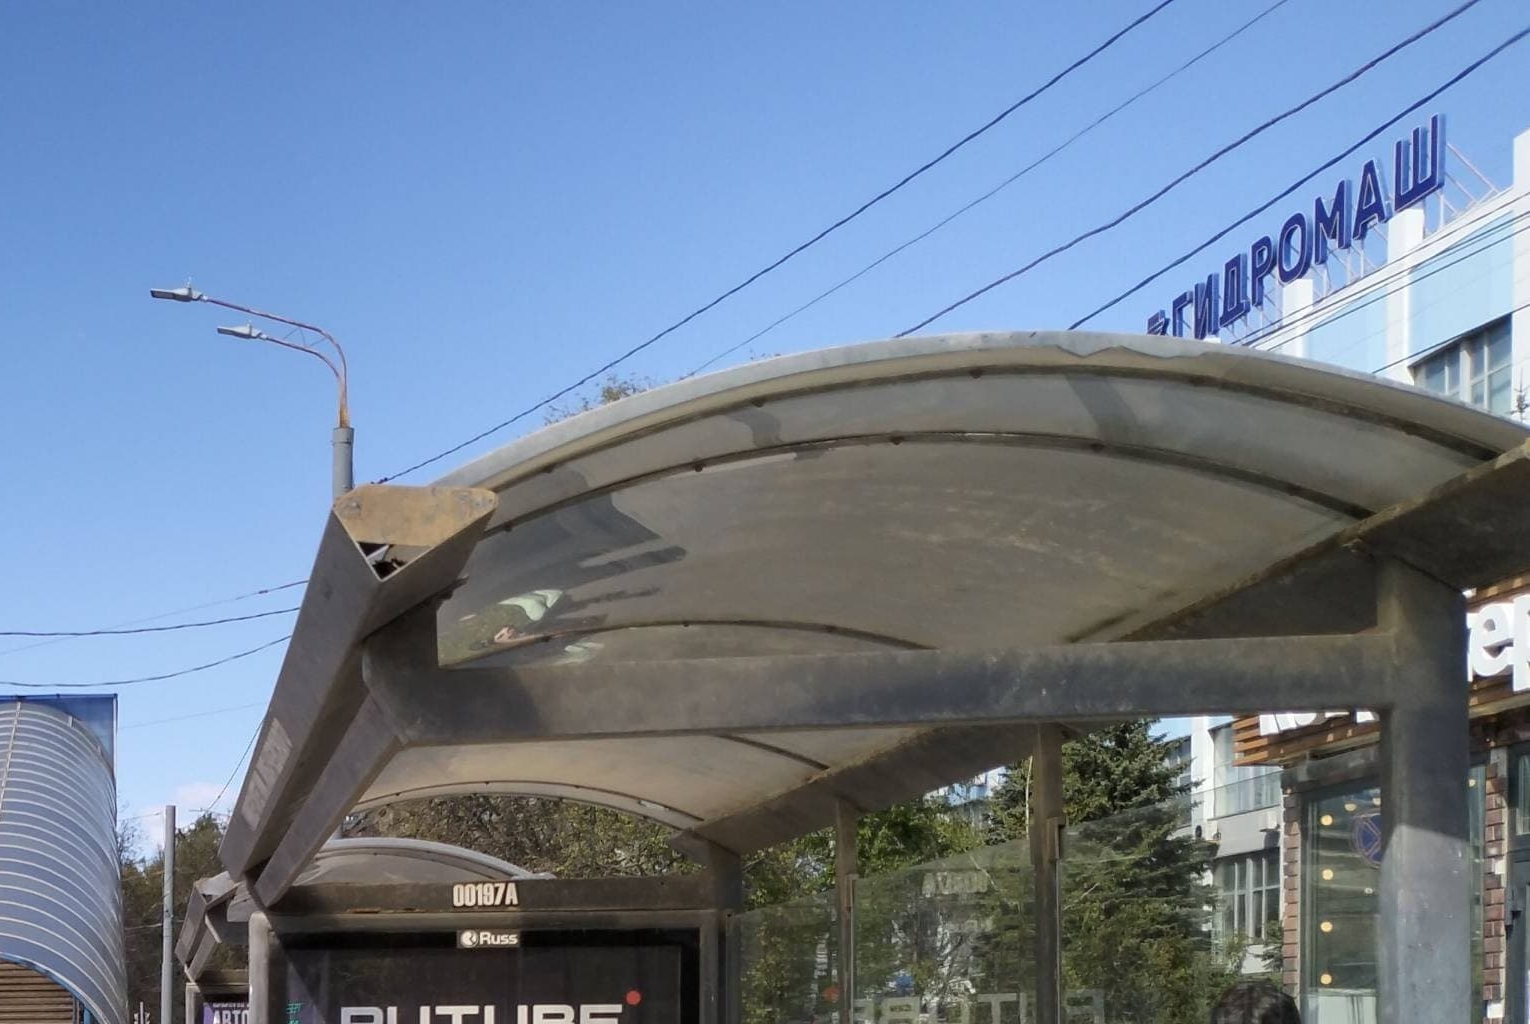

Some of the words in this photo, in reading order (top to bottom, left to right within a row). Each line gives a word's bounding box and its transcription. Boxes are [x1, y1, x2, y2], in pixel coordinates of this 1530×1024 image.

[1172, 113, 1447, 340] ГИДРОМАШ
[453, 882, 519, 907] 00197A
[479, 931, 519, 946] Russ
